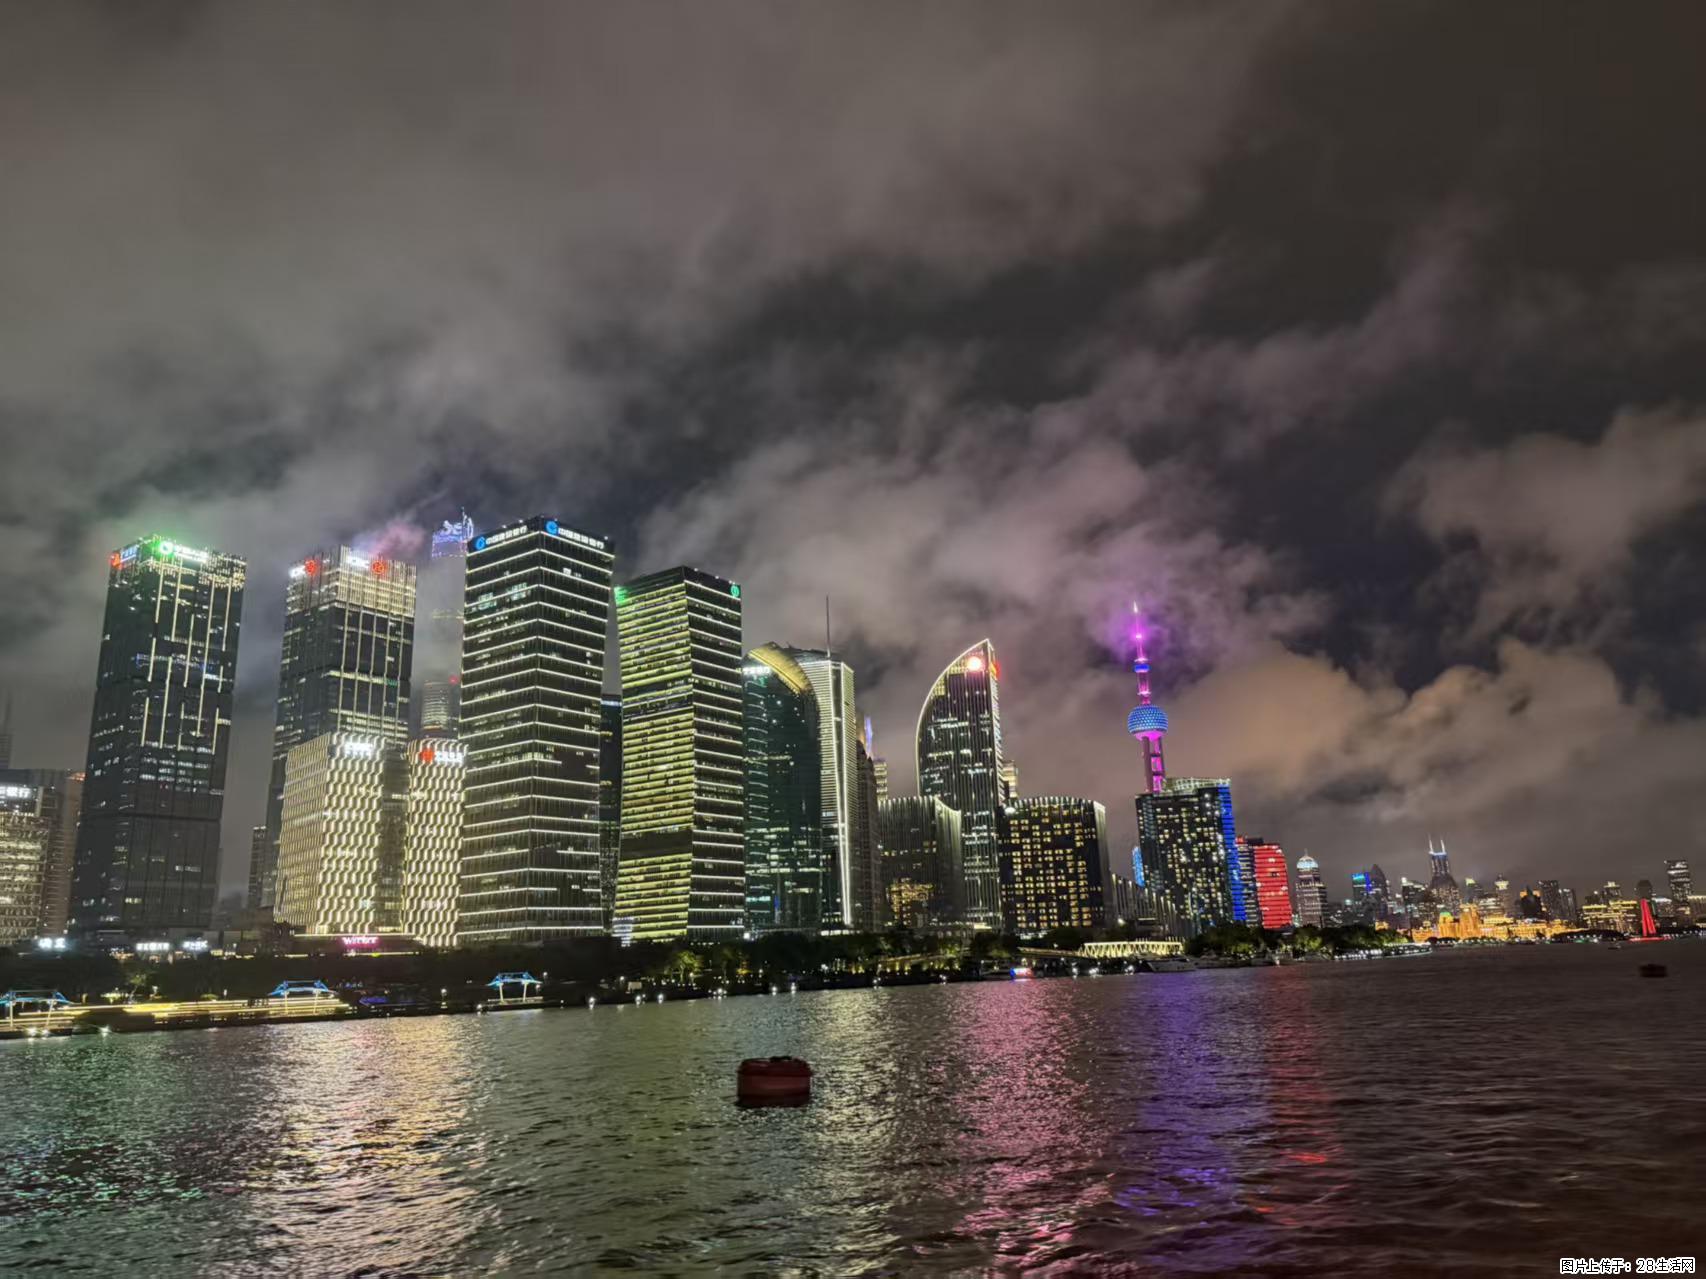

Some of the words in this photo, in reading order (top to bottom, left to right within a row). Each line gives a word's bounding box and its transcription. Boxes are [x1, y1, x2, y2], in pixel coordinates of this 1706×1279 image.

[558, 527, 605, 549] 中国建设银行
